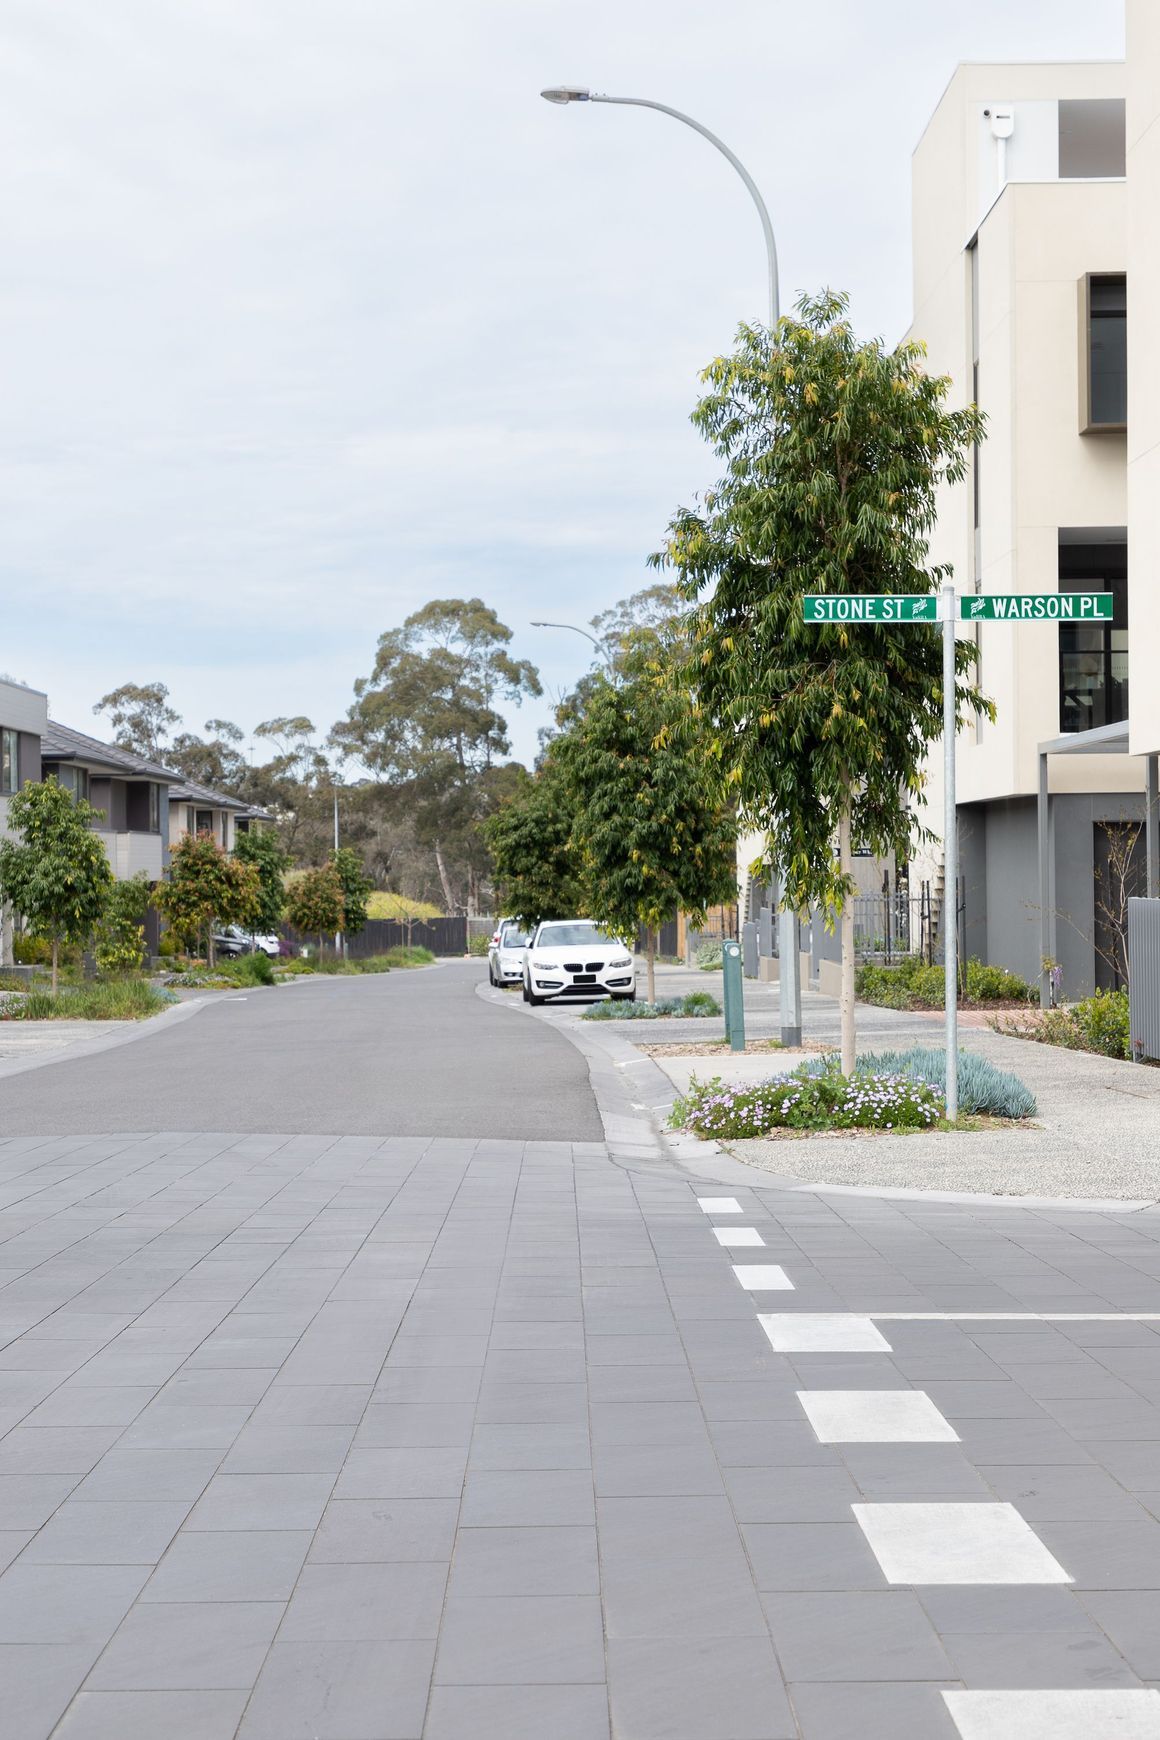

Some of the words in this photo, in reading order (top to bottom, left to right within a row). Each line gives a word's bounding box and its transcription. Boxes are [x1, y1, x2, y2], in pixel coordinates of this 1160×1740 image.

[813, 598, 875, 619] STONE
[881, 598, 905, 619] ST
[992, 597, 1073, 618] WARSON
[1080, 596, 1105, 617] PL
